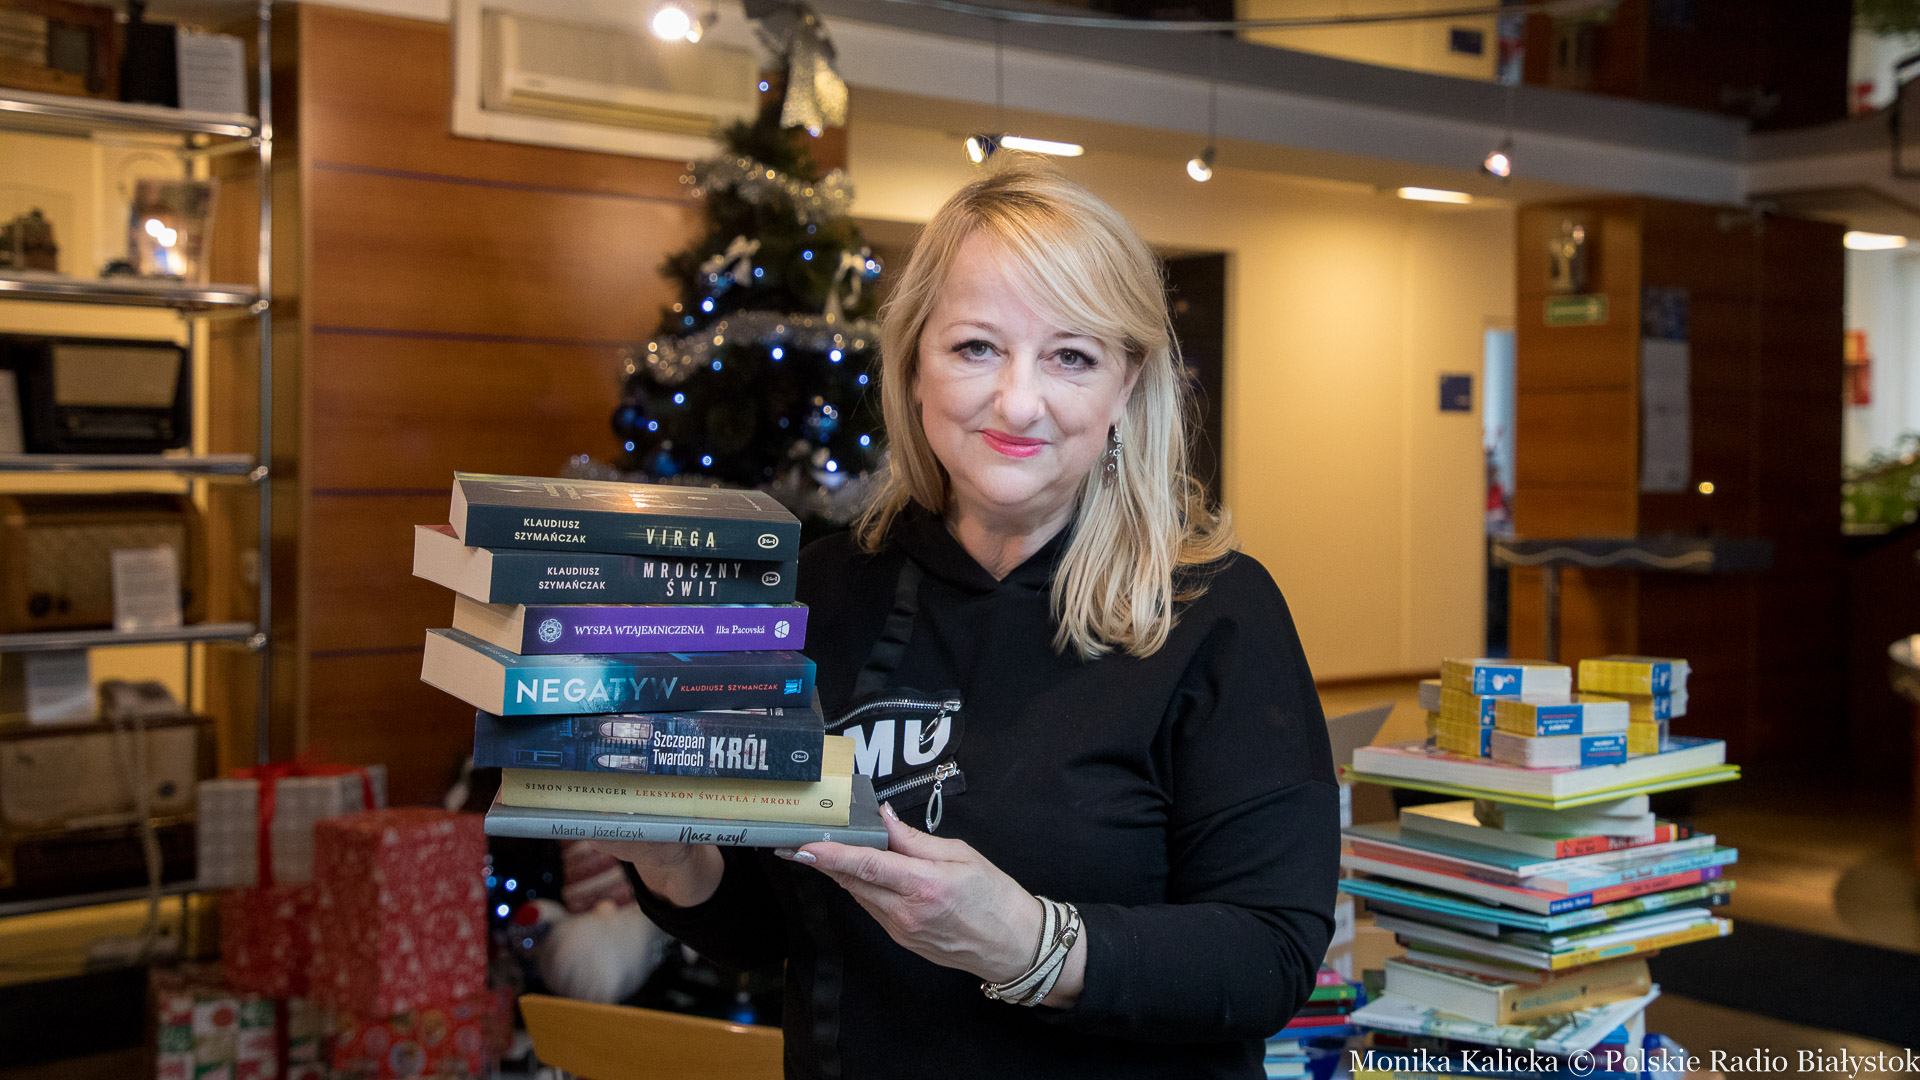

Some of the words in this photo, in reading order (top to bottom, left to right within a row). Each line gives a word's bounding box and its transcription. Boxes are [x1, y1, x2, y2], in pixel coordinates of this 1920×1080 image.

[523, 518, 580, 529] KLAUDIUSZ
[514, 531, 587, 543] SZYMAŃCZAK
[646, 528, 715, 548] VIRGA
[547, 567, 600, 576] KLAUDIUSZ
[643, 562, 742, 579] MROCZNY
[538, 579, 606, 590] SZYMAŃCZAK
[666, 578, 717, 597] ŚWIT
[574, 625, 613, 635] WYSPA
[614, 625, 705, 637] WTAJEMNICZENIA
[715, 625, 730, 635] Ilka
[516, 676, 678, 704] NEGATYW
[680, 684, 724, 692] KLAUDIUSZ
[653, 730, 706, 750] Szczepan
[652, 748, 704, 767] Twardoch
[708, 733, 769, 771] KRÓL
[525, 782, 563, 792] SIMON
[567, 785, 628, 796] STRANGER
[635, 789, 694, 799] LEKSYKON
[698, 791, 749, 803] ŚWIATŁA
[760, 797, 801, 806] MROKU
[551, 824, 586, 837] Marta
[592, 826, 645, 841] Józefczyk
[679, 826, 711, 843] Nasz
[716, 828, 748, 844] azyl
